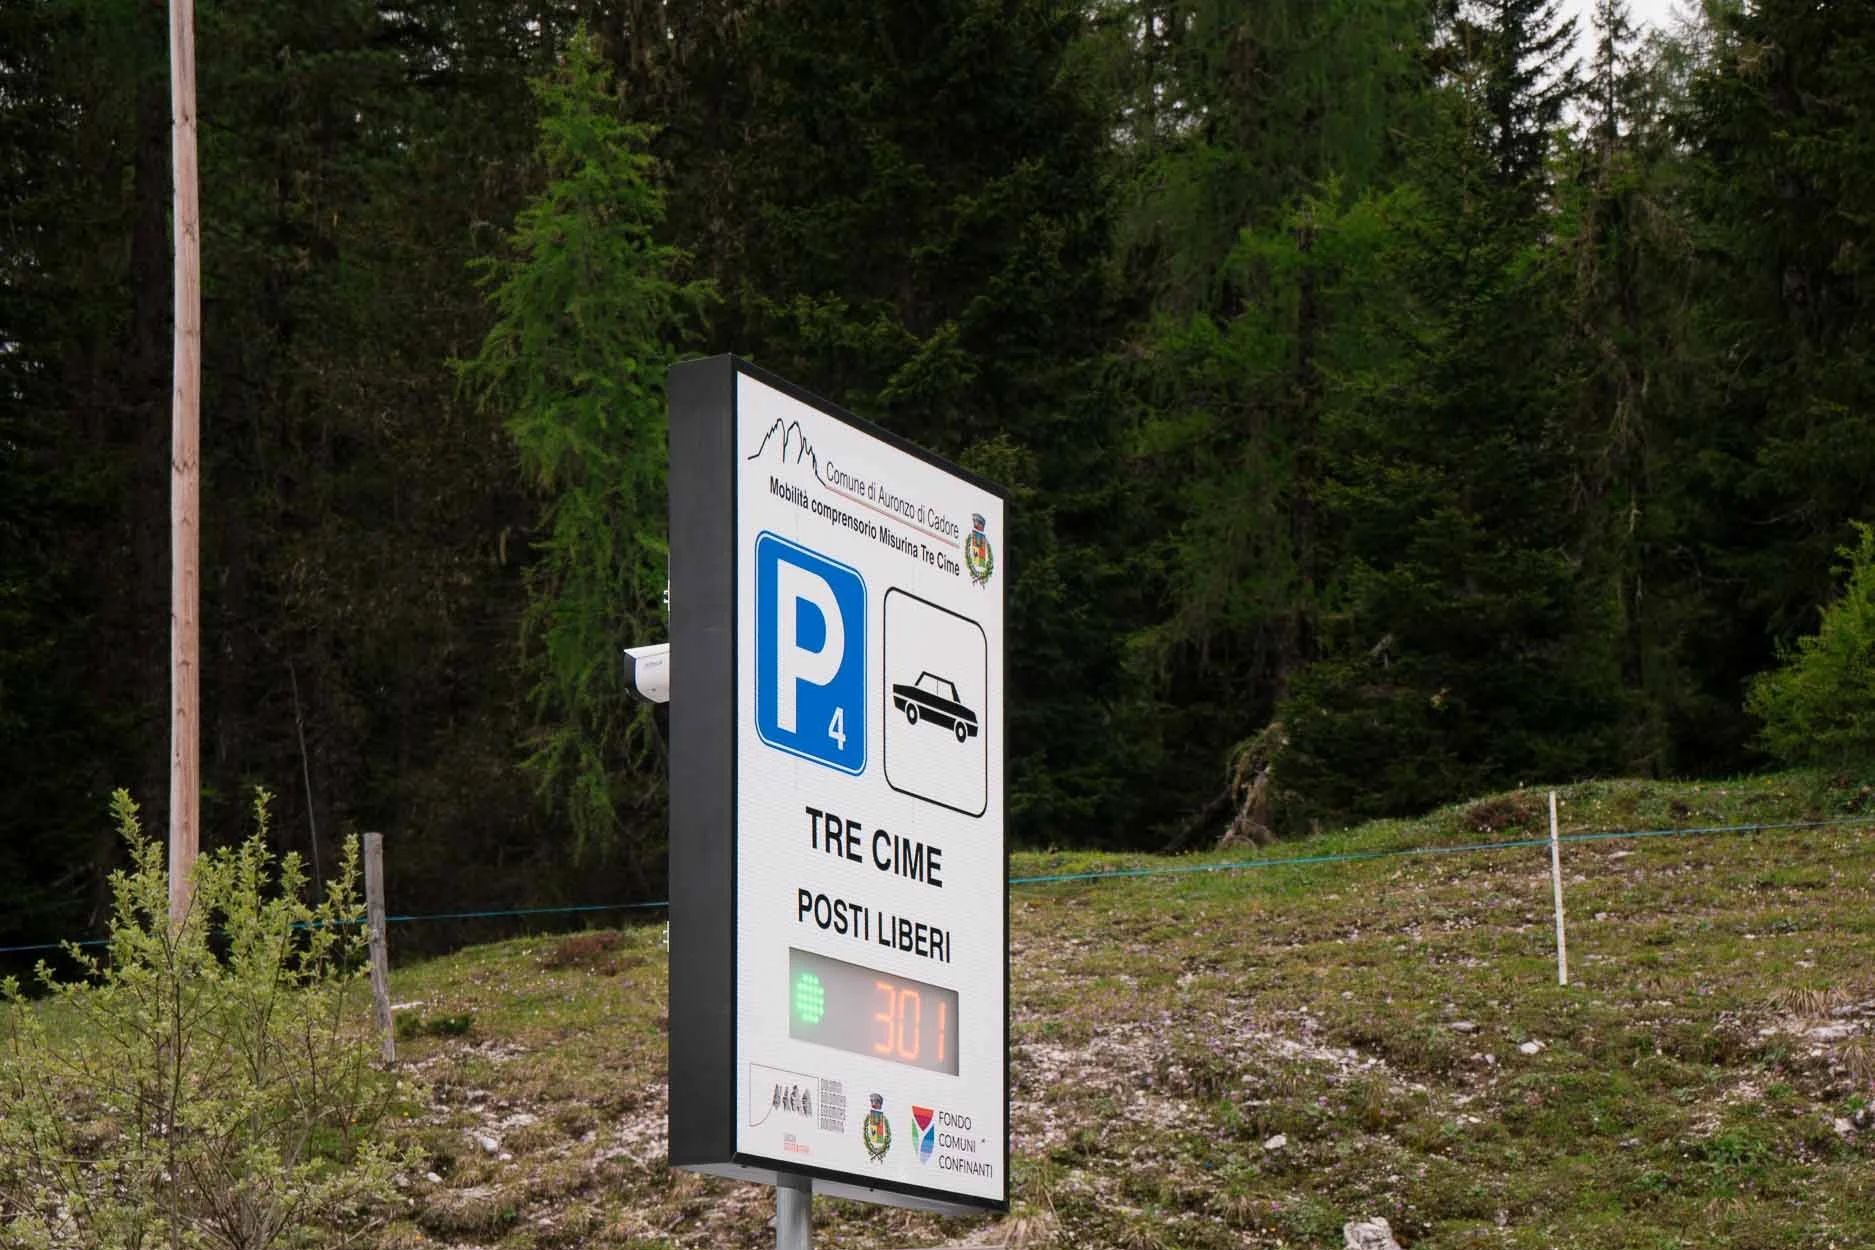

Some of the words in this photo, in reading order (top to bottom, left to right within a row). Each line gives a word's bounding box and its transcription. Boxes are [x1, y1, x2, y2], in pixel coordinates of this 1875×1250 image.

[770, 476, 809, 510] Mobilità
[811, 496, 877, 540] comprensorio
[879, 525, 919, 559] Misurina
[920, 544, 935, 565] Tre
[936, 555, 960, 576] Cime
[826, 461, 865, 496] Comune
[867, 481, 876, 500] di
[878, 485, 915, 519] Auronzo
[917, 504, 925, 525] di
[927, 508, 960, 539] Cadore
[777, 559, 845, 734] P
[828, 707, 846, 750] 4
[806, 806, 862, 863] TRE
[872, 829, 942, 888] CIME
[798, 888, 869, 941] POSTI
[878, 911, 950, 963] LIBERI
[874, 981, 946, 1063] 301
[938, 1111, 972, 1131] FONDO
[938, 1132, 976, 1153] COMUNI
[938, 1155, 993, 1178] CONFINANTI
